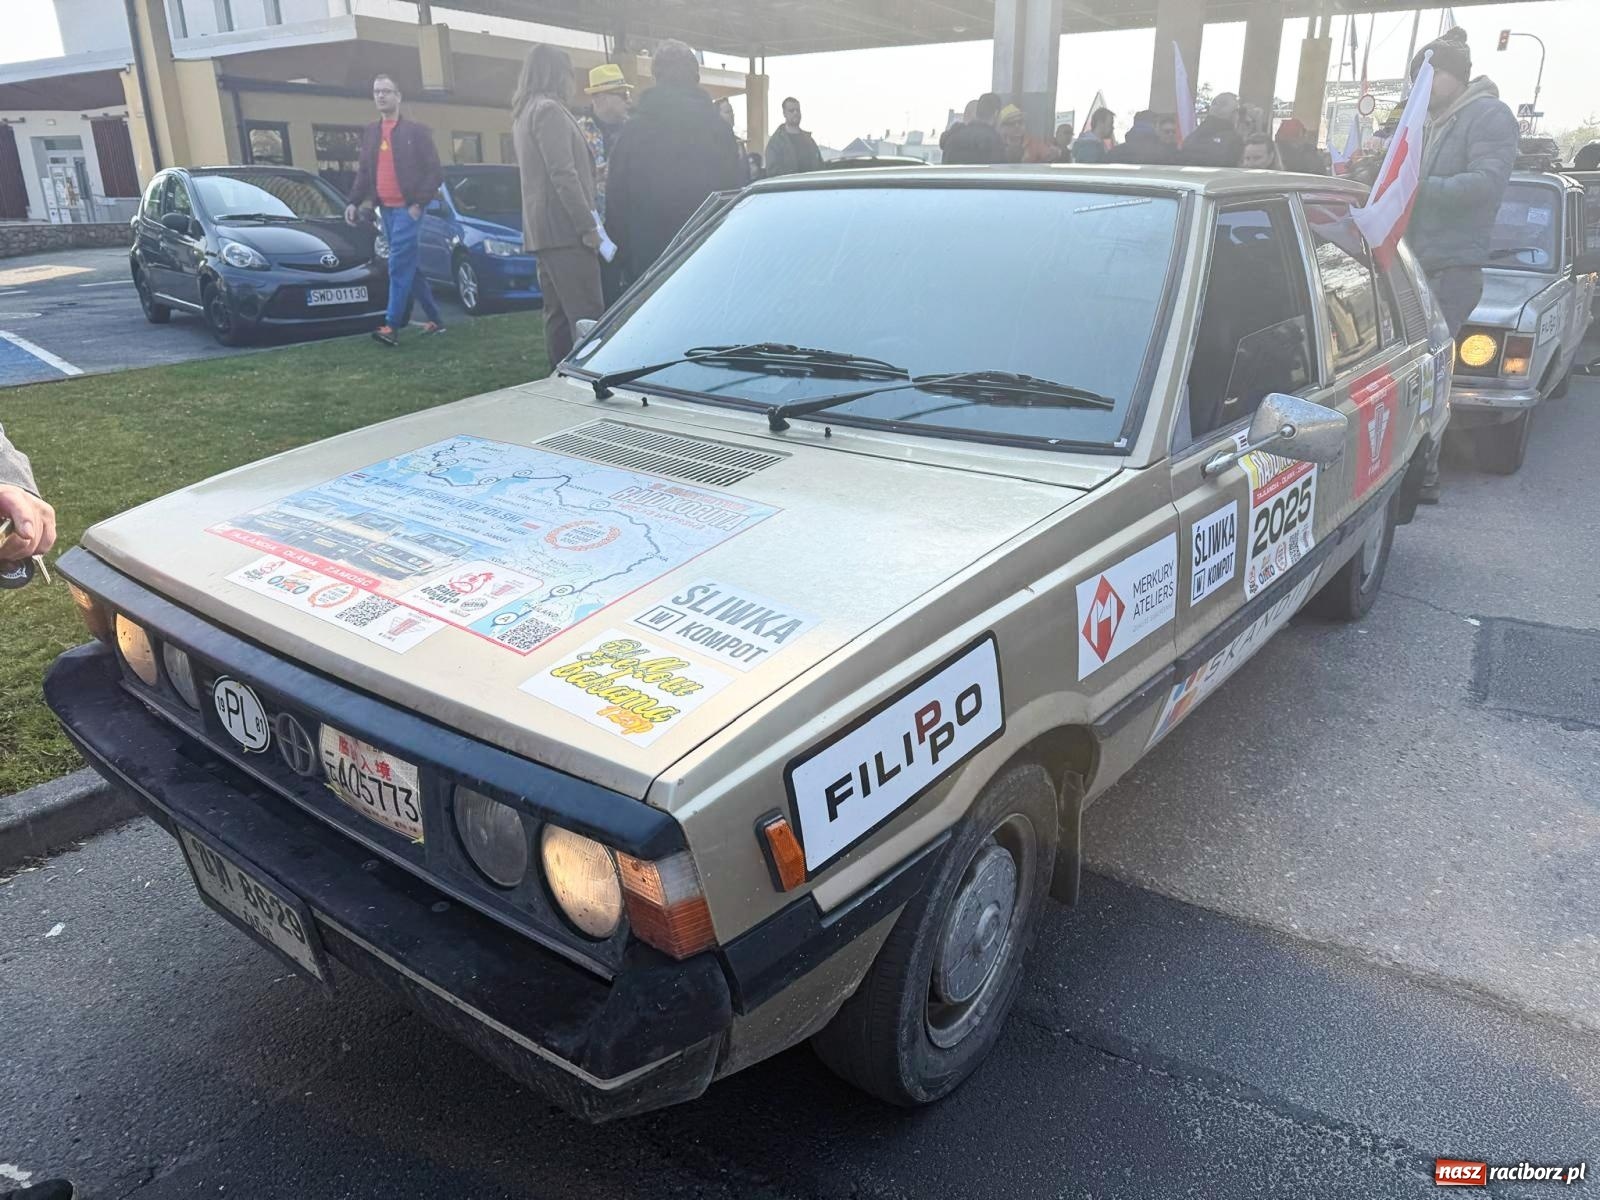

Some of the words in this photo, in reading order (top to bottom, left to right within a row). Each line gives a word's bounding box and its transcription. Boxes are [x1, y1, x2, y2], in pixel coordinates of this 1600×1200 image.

[312, 290, 333, 303] SWD
[335, 287, 367, 301] 01130
[459, 500, 481, 510] DO
[477, 504, 525, 523] POLSKI
[608, 486, 674, 510] RAJD
[659, 497, 751, 532] KOGUTA
[1252, 475, 1313, 559] 2025
[1194, 513, 1235, 567] ŚLIWKA
[1133, 560, 1174, 598] MERKURY
[1196, 574, 1203, 594] W
[1207, 553, 1234, 587] KOMPOT
[672, 583, 805, 645] ŚLIWKA
[1133, 581, 1174, 620] ATELIERS
[649, 610, 675, 625] W
[675, 621, 769, 663] KOMPOT
[217, 695, 226, 712] 19
[224, 687, 257, 741] PL
[255, 718, 265, 735] 81
[824, 683, 983, 823] FILIPPO
[238, 872, 306, 944] 8629
